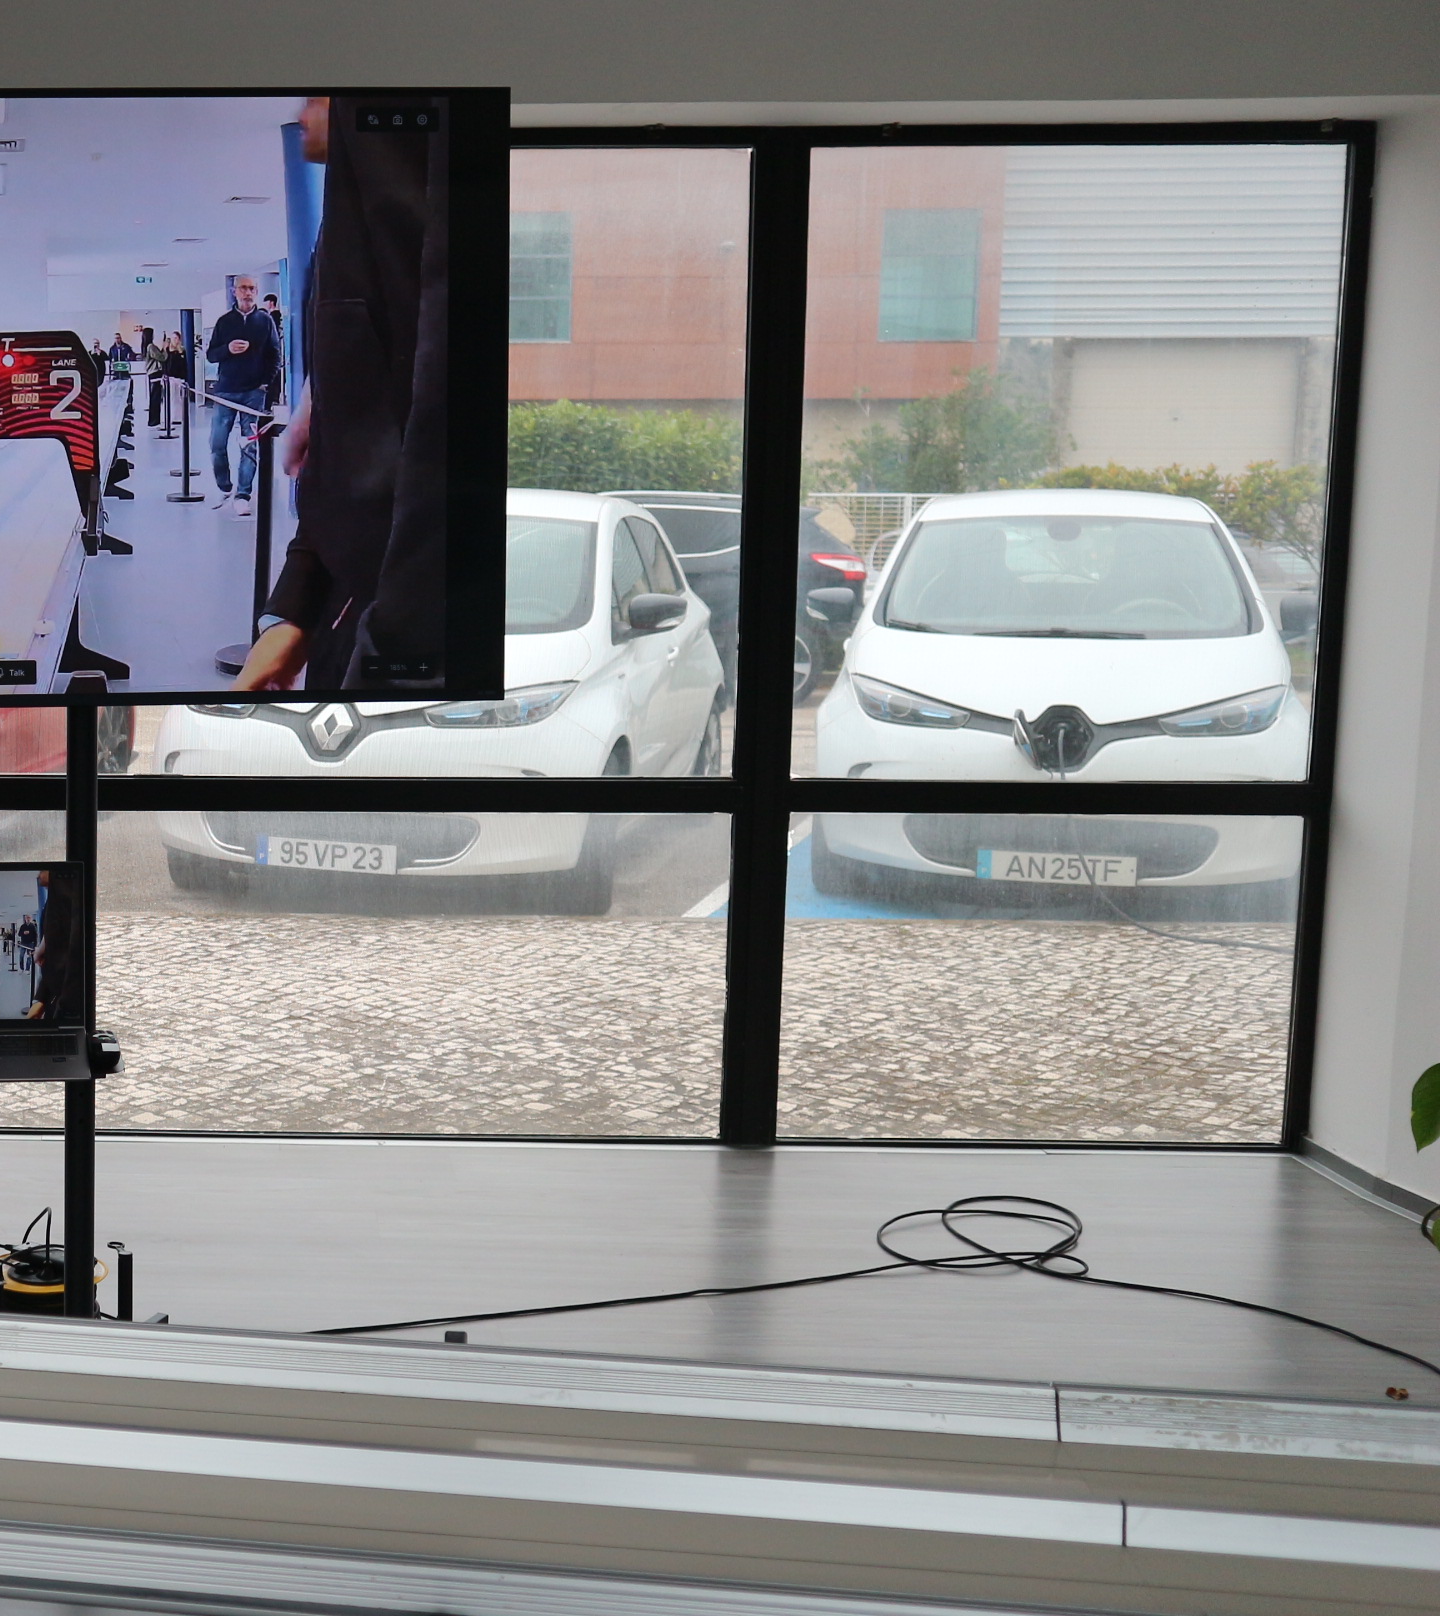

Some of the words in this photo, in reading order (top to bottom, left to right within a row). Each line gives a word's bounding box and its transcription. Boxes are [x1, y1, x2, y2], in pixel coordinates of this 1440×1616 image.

[51, 358, 77, 367] LANE
[49, 369, 82, 420] 2
[9, 668, 25, 677] Talk
[280, 841, 309, 865] 95
[314, 843, 348, 868] VP
[352, 847, 383, 871] 23
